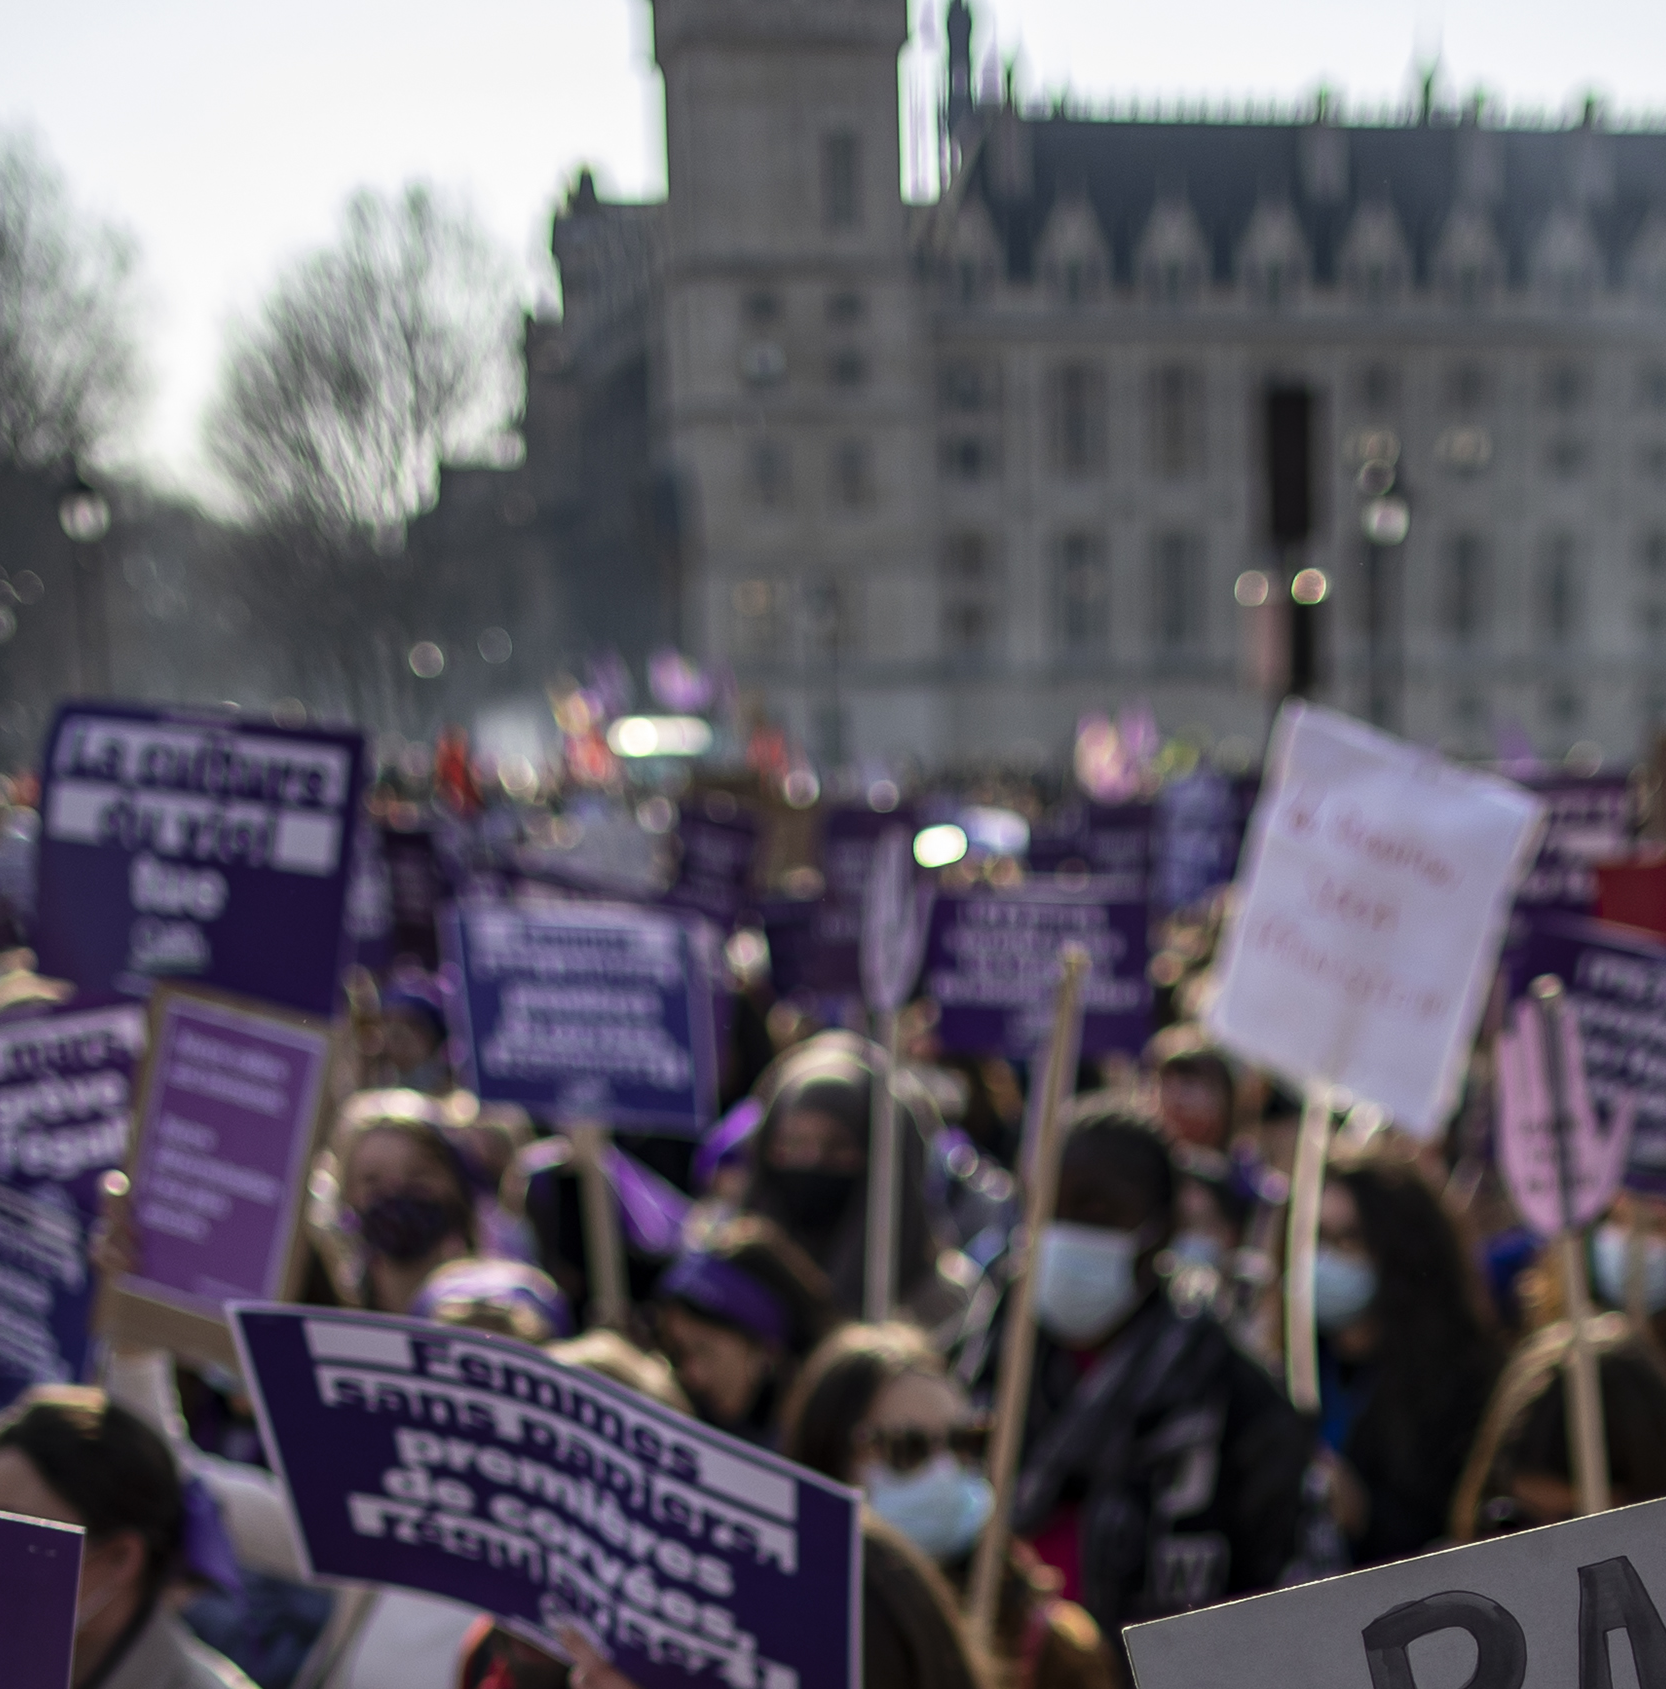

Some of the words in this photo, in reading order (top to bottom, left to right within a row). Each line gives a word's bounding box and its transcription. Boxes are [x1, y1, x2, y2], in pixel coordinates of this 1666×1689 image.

[335, 1374, 494, 1430] sans
[413, 1336, 699, 1484] Femmes
[379, 1464, 477, 1513] de
[489, 1492, 758, 1657] corvées,
[393, 1425, 735, 1598] premières
